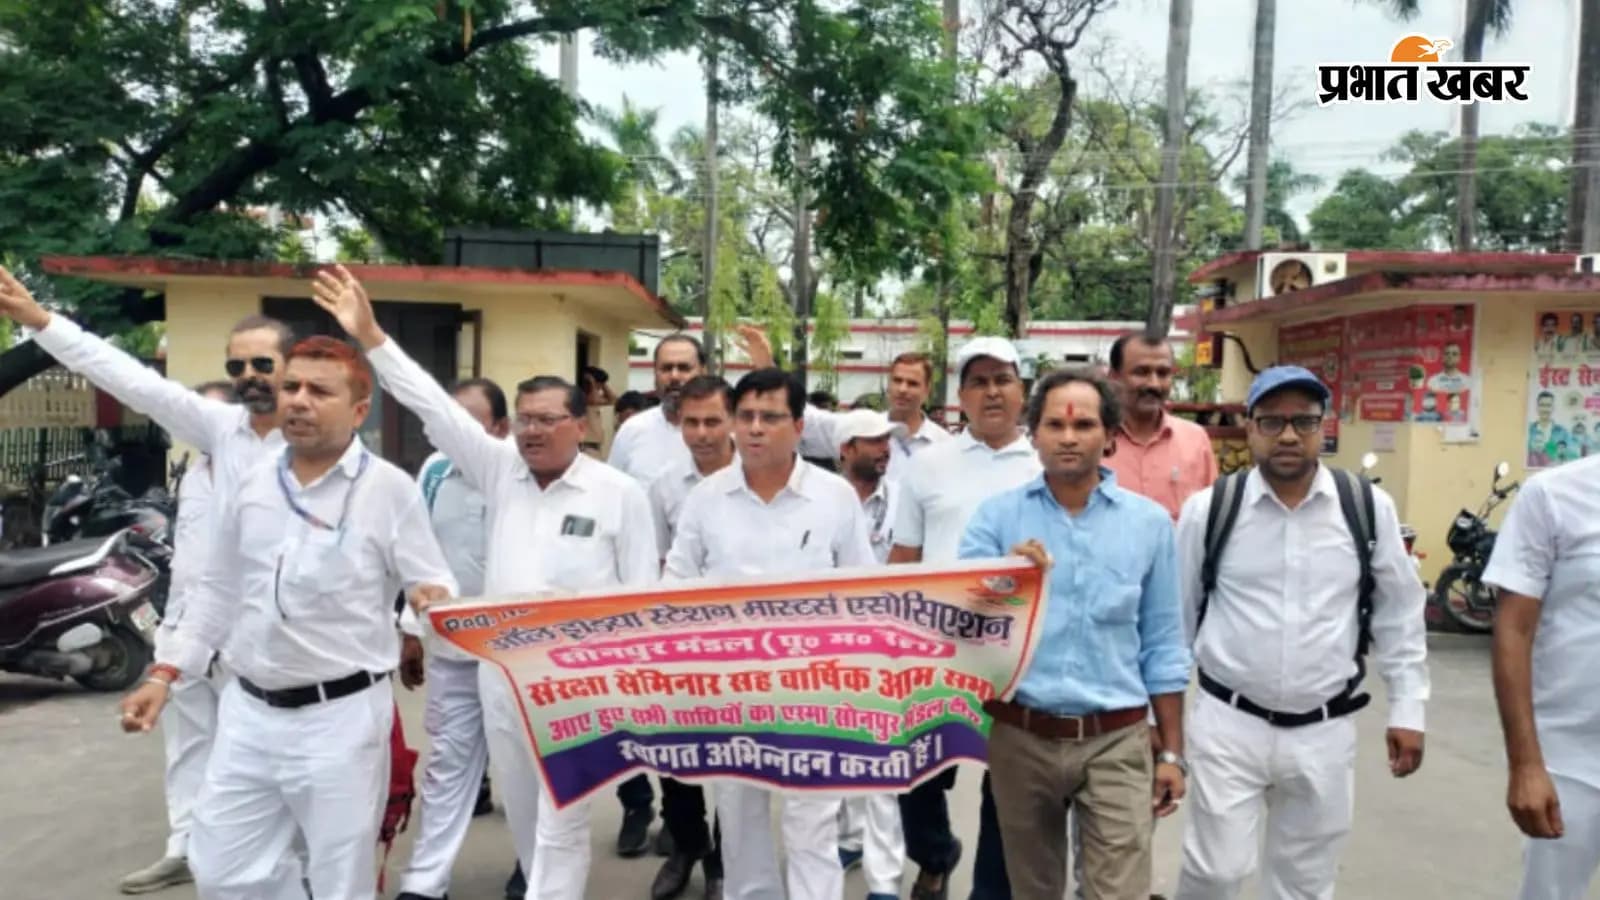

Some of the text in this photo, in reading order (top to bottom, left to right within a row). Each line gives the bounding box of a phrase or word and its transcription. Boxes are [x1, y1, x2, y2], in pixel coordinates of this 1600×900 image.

[643, 604, 736, 625] स्टेशन
[845, 590, 1014, 639] एसोसिएशन
[551, 640, 669, 665] सोनपुर
[672, 637, 753, 653] मंडल
[527, 675, 609, 706] संरक्षा
[614, 669, 722, 697] सेमिनार
[727, 671, 773, 693] सह
[777, 659, 871, 691] वार्षिक
[877, 666, 937, 702] आम
[548, 712, 593, 742] आए
[595, 706, 626, 733] हुए
[748, 704, 776, 724] का
[833, 702, 900, 743] सोनपुर
[617, 740, 699, 769] स्वागत
[838, 750, 911, 779] करती
